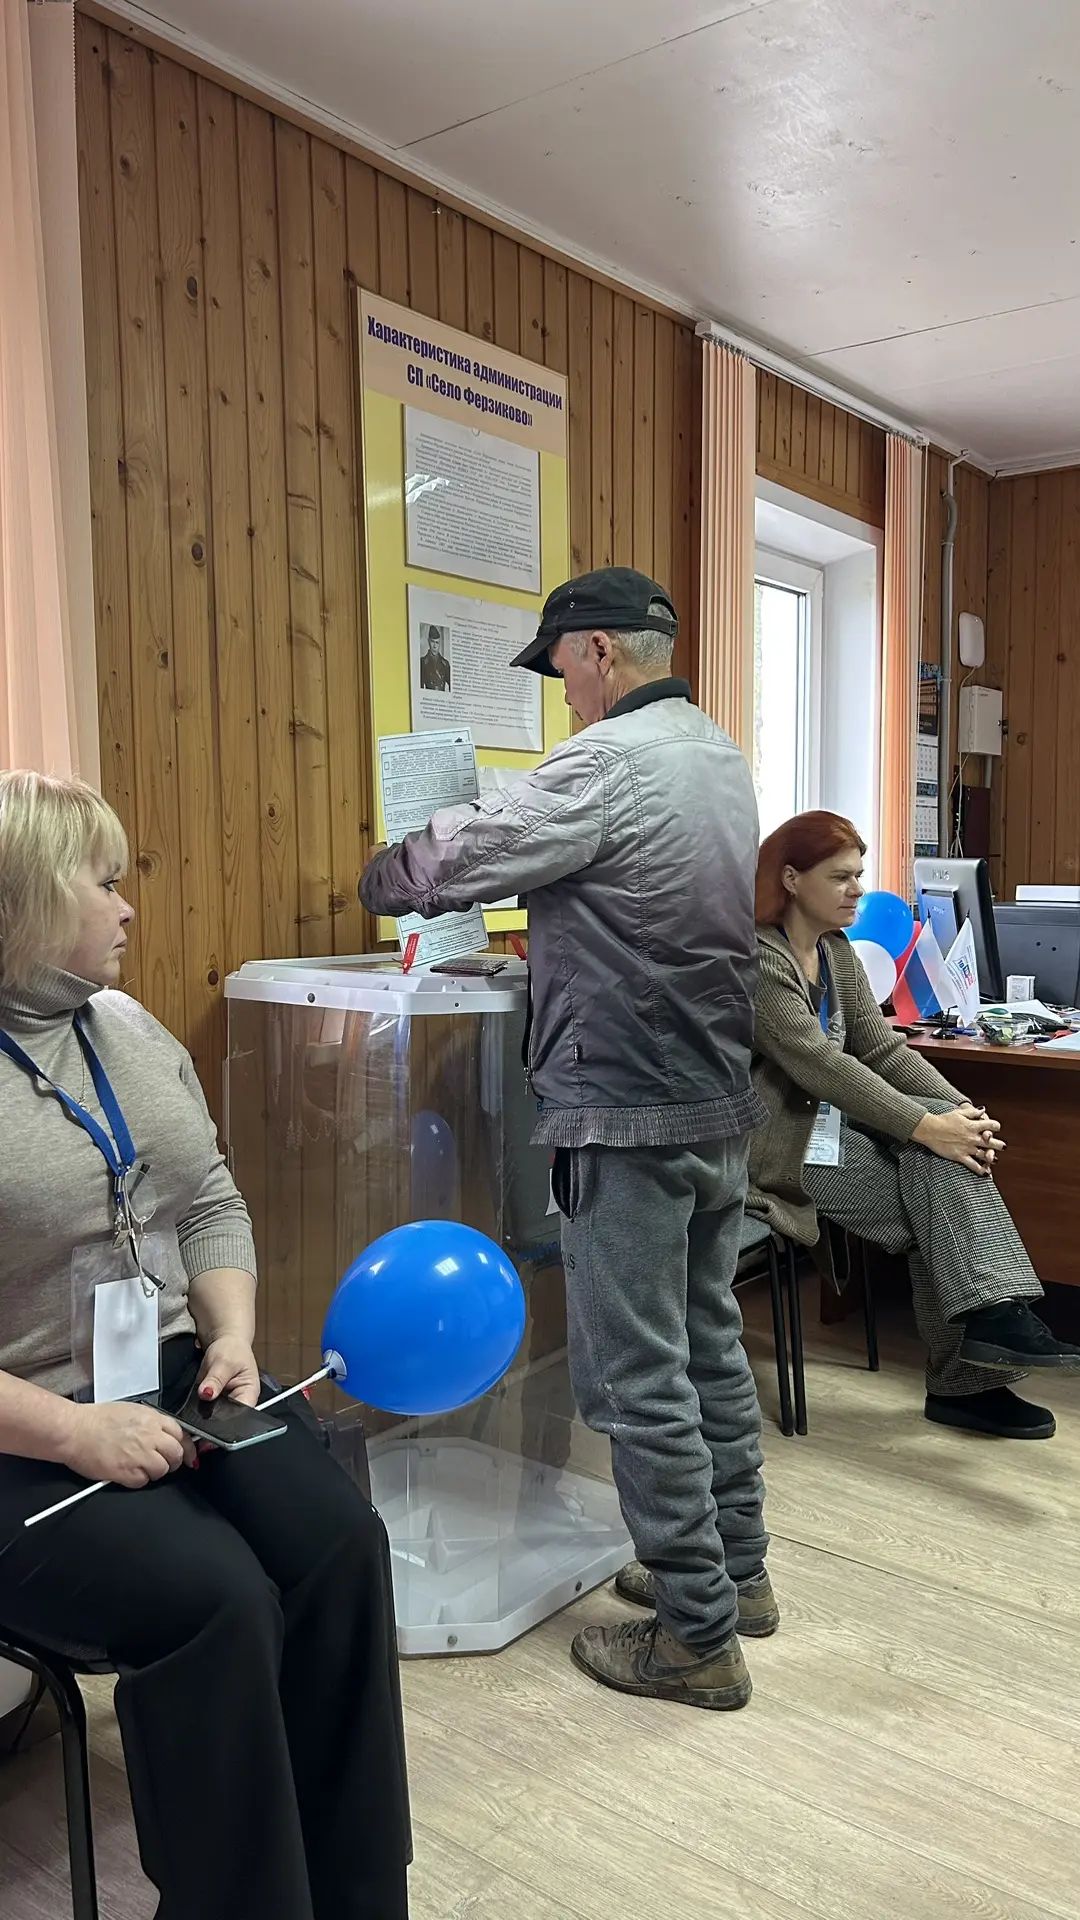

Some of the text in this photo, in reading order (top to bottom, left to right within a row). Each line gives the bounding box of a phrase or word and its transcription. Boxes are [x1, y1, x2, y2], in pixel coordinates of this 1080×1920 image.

[367, 315, 563, 410] Характеристика администрации
[407, 364, 533, 427] СП «Село Ферзиково»
